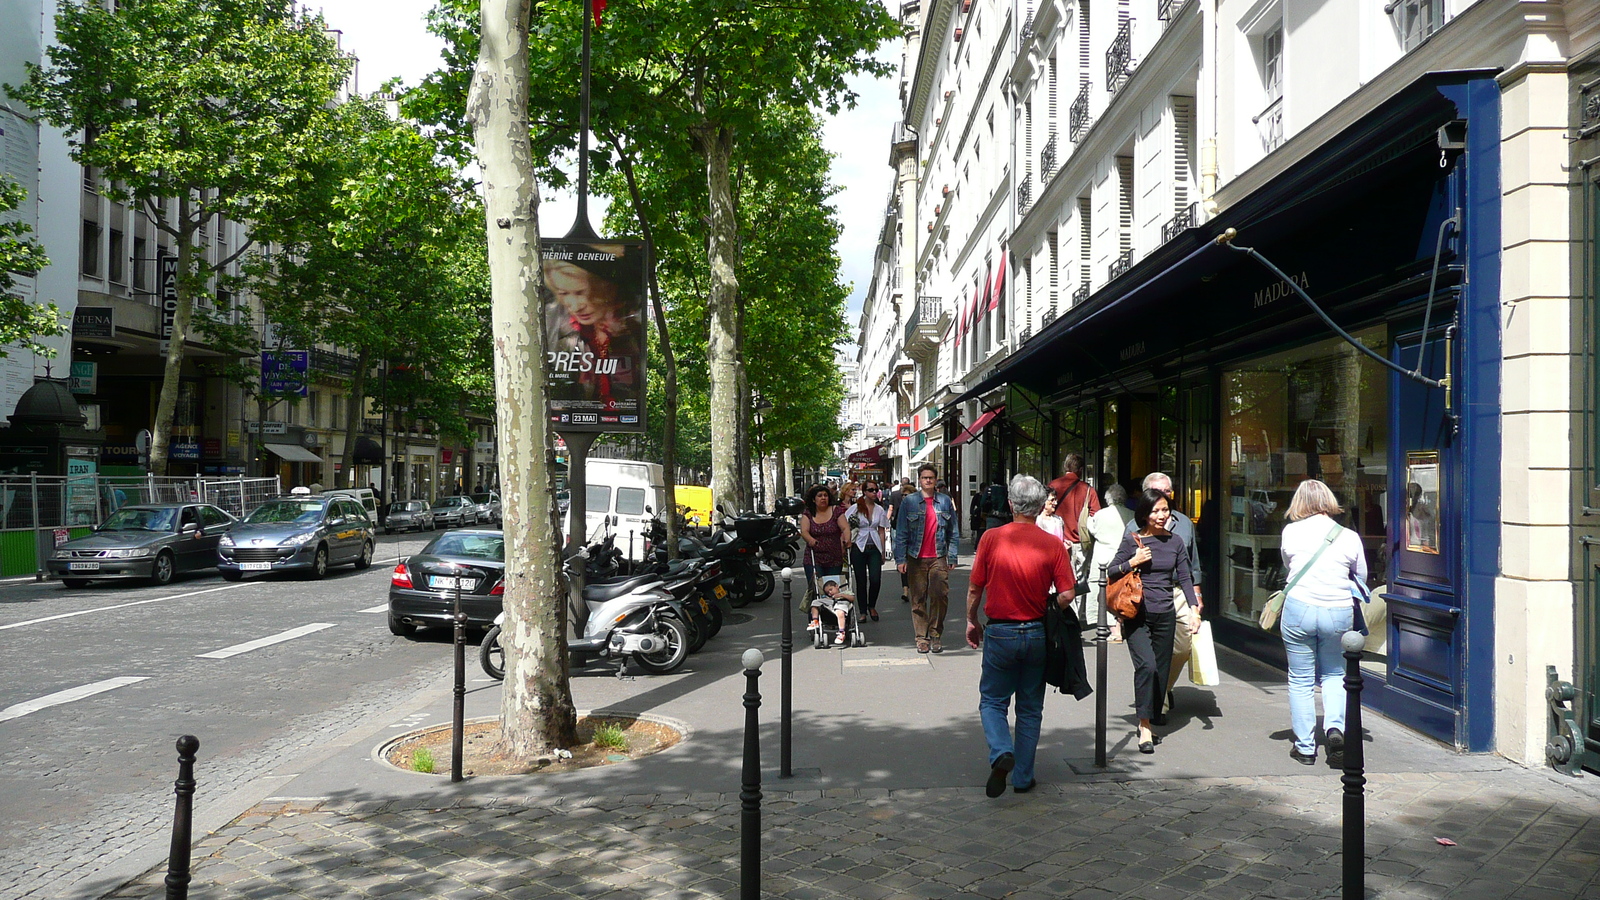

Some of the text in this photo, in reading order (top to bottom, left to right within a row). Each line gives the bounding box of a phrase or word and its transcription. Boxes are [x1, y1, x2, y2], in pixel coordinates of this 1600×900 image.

[577, 252, 616, 261] DENEUVE
[1253, 270, 1310, 309] MADURA
[1119, 340, 1146, 362] MADURA
[595, 359, 618, 374] LUI
[69, 465, 89, 474] IRAN
[461, 579, 474, 587] 120
